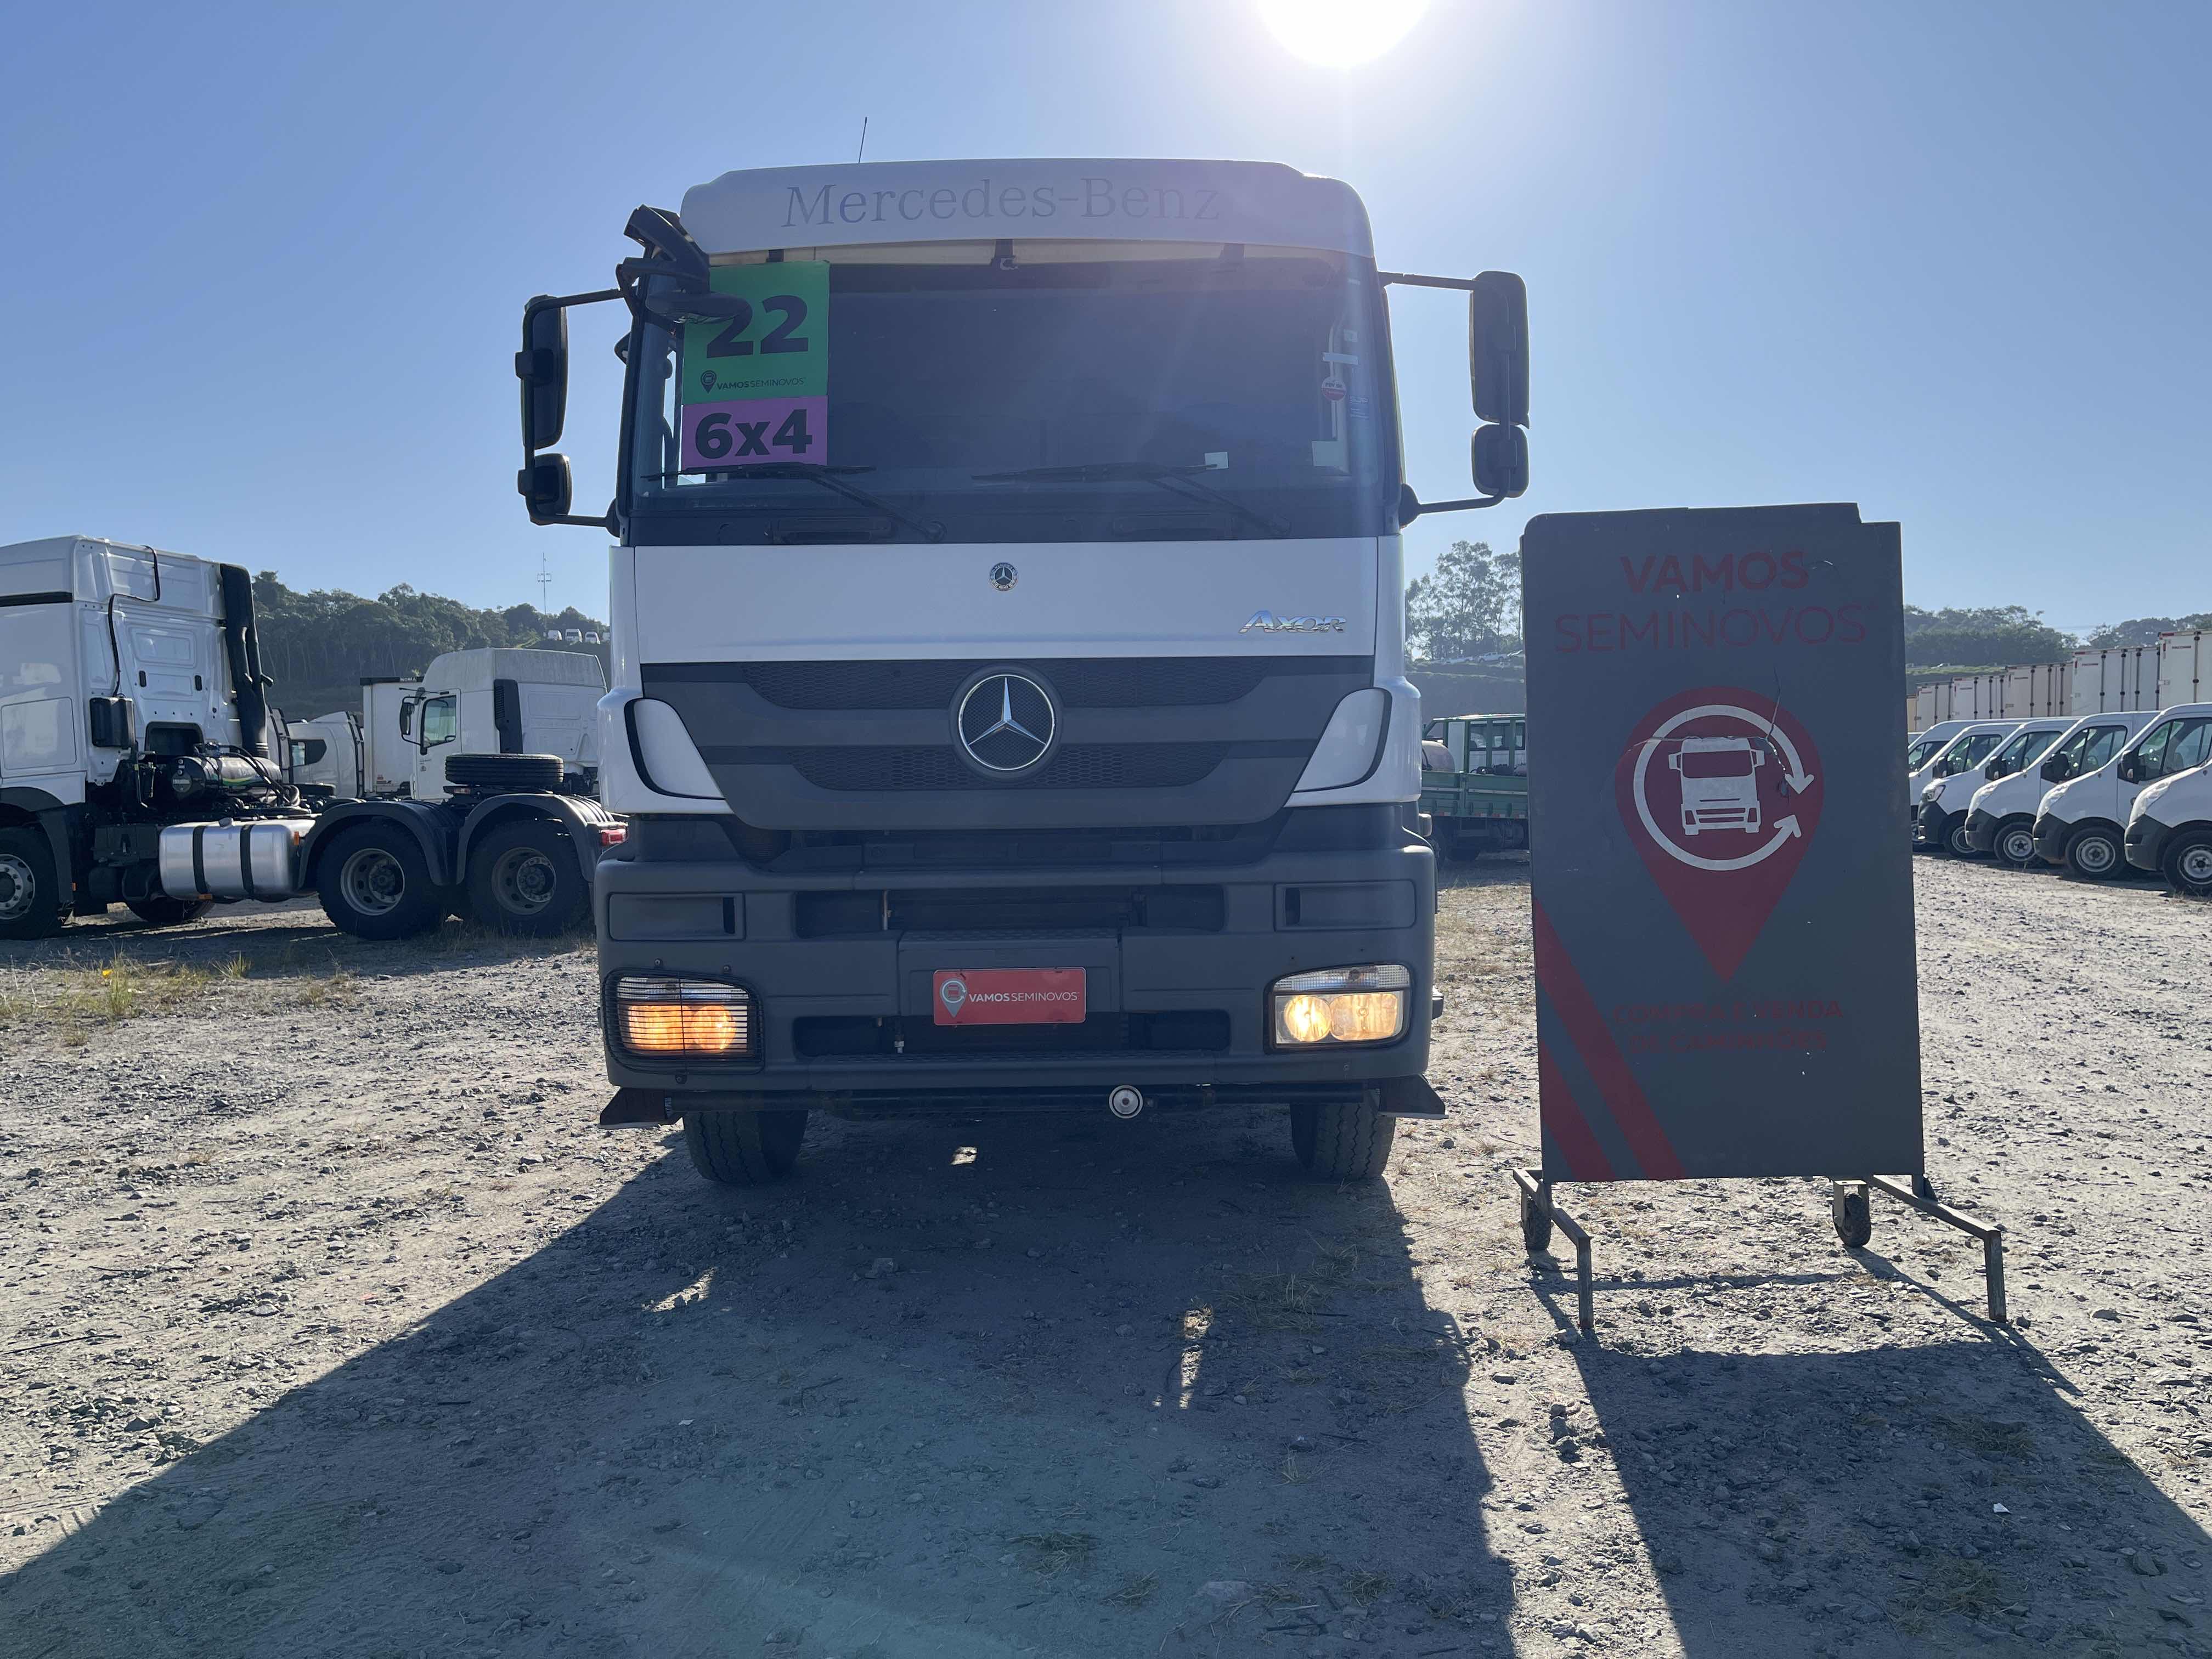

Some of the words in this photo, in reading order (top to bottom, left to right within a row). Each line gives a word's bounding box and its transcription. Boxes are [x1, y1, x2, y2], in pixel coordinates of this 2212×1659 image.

[781, 178, 1220, 227] Mercedes-Benz
[706, 295, 809, 359] 22
[695, 409, 812, 459] 6x4
[1620, 551, 1810, 594] VAMOS
[1554, 605, 1866, 653] SEMINOVOS
